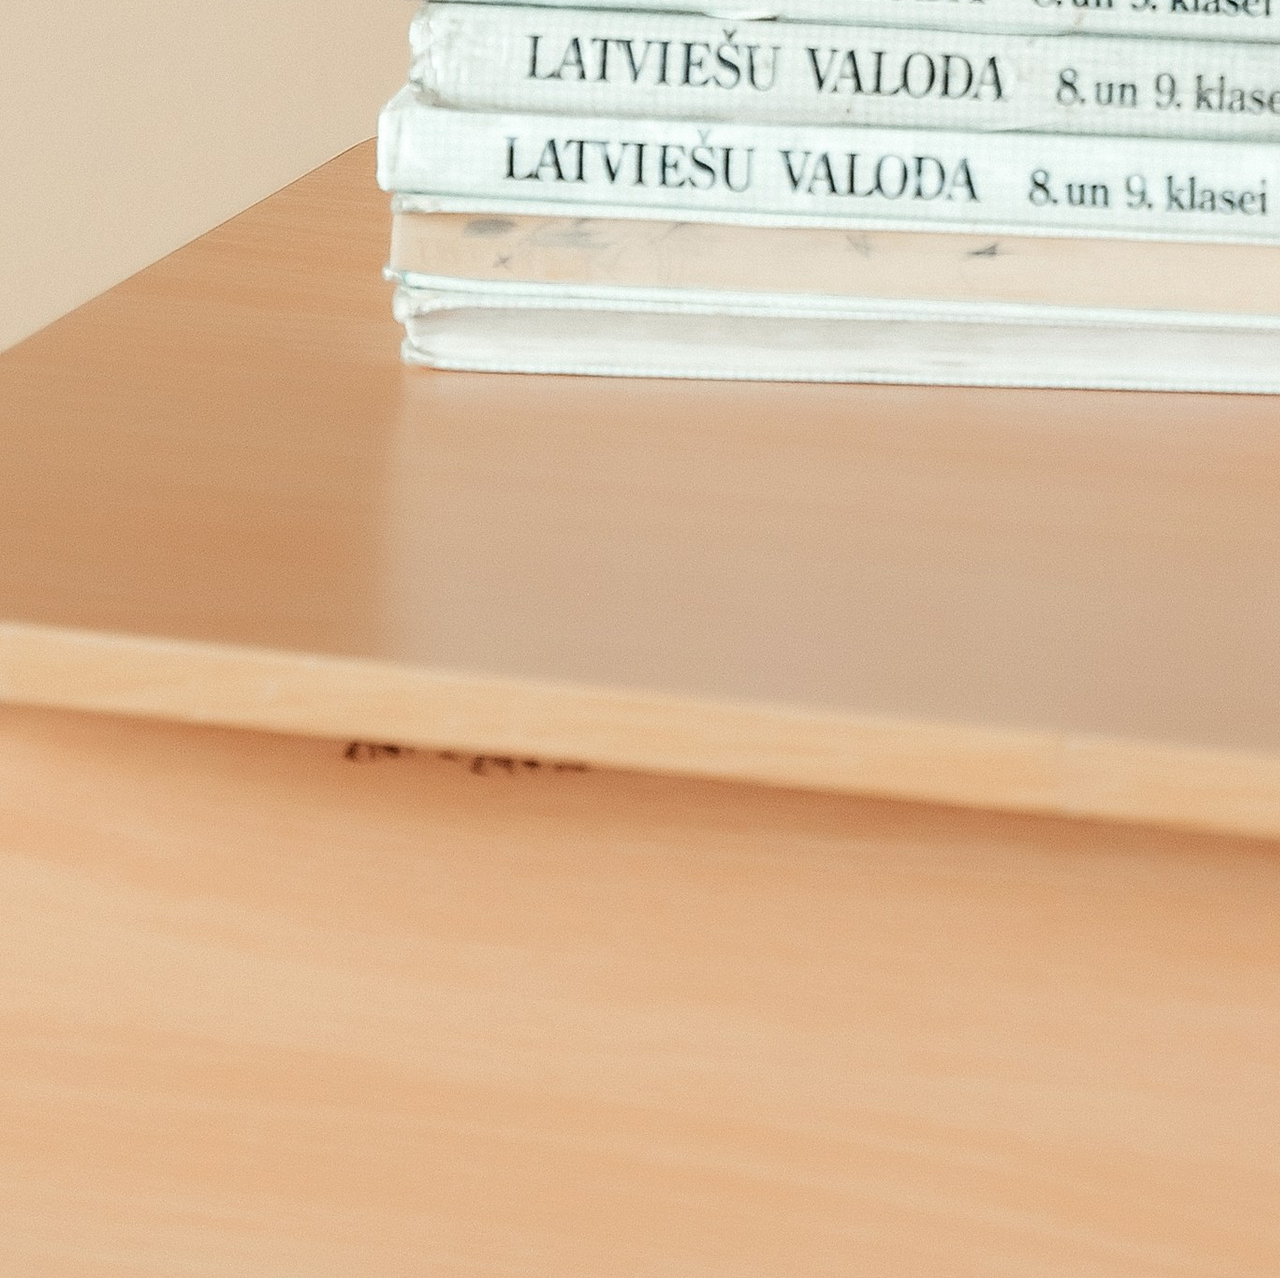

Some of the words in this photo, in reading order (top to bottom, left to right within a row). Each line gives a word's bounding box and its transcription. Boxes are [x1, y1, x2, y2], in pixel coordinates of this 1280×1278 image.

[526, 28, 782, 92] LATVIEŠU
[804, 45, 1007, 102] VALODA
[1154, 72, 1182, 110] 9.
[504, 129, 754, 193] LATVIEŠU
[777, 149, 981, 202] VALODA
[1125, 173, 1154, 210] 9.
[1165, 174, 1268, 216] klasei
